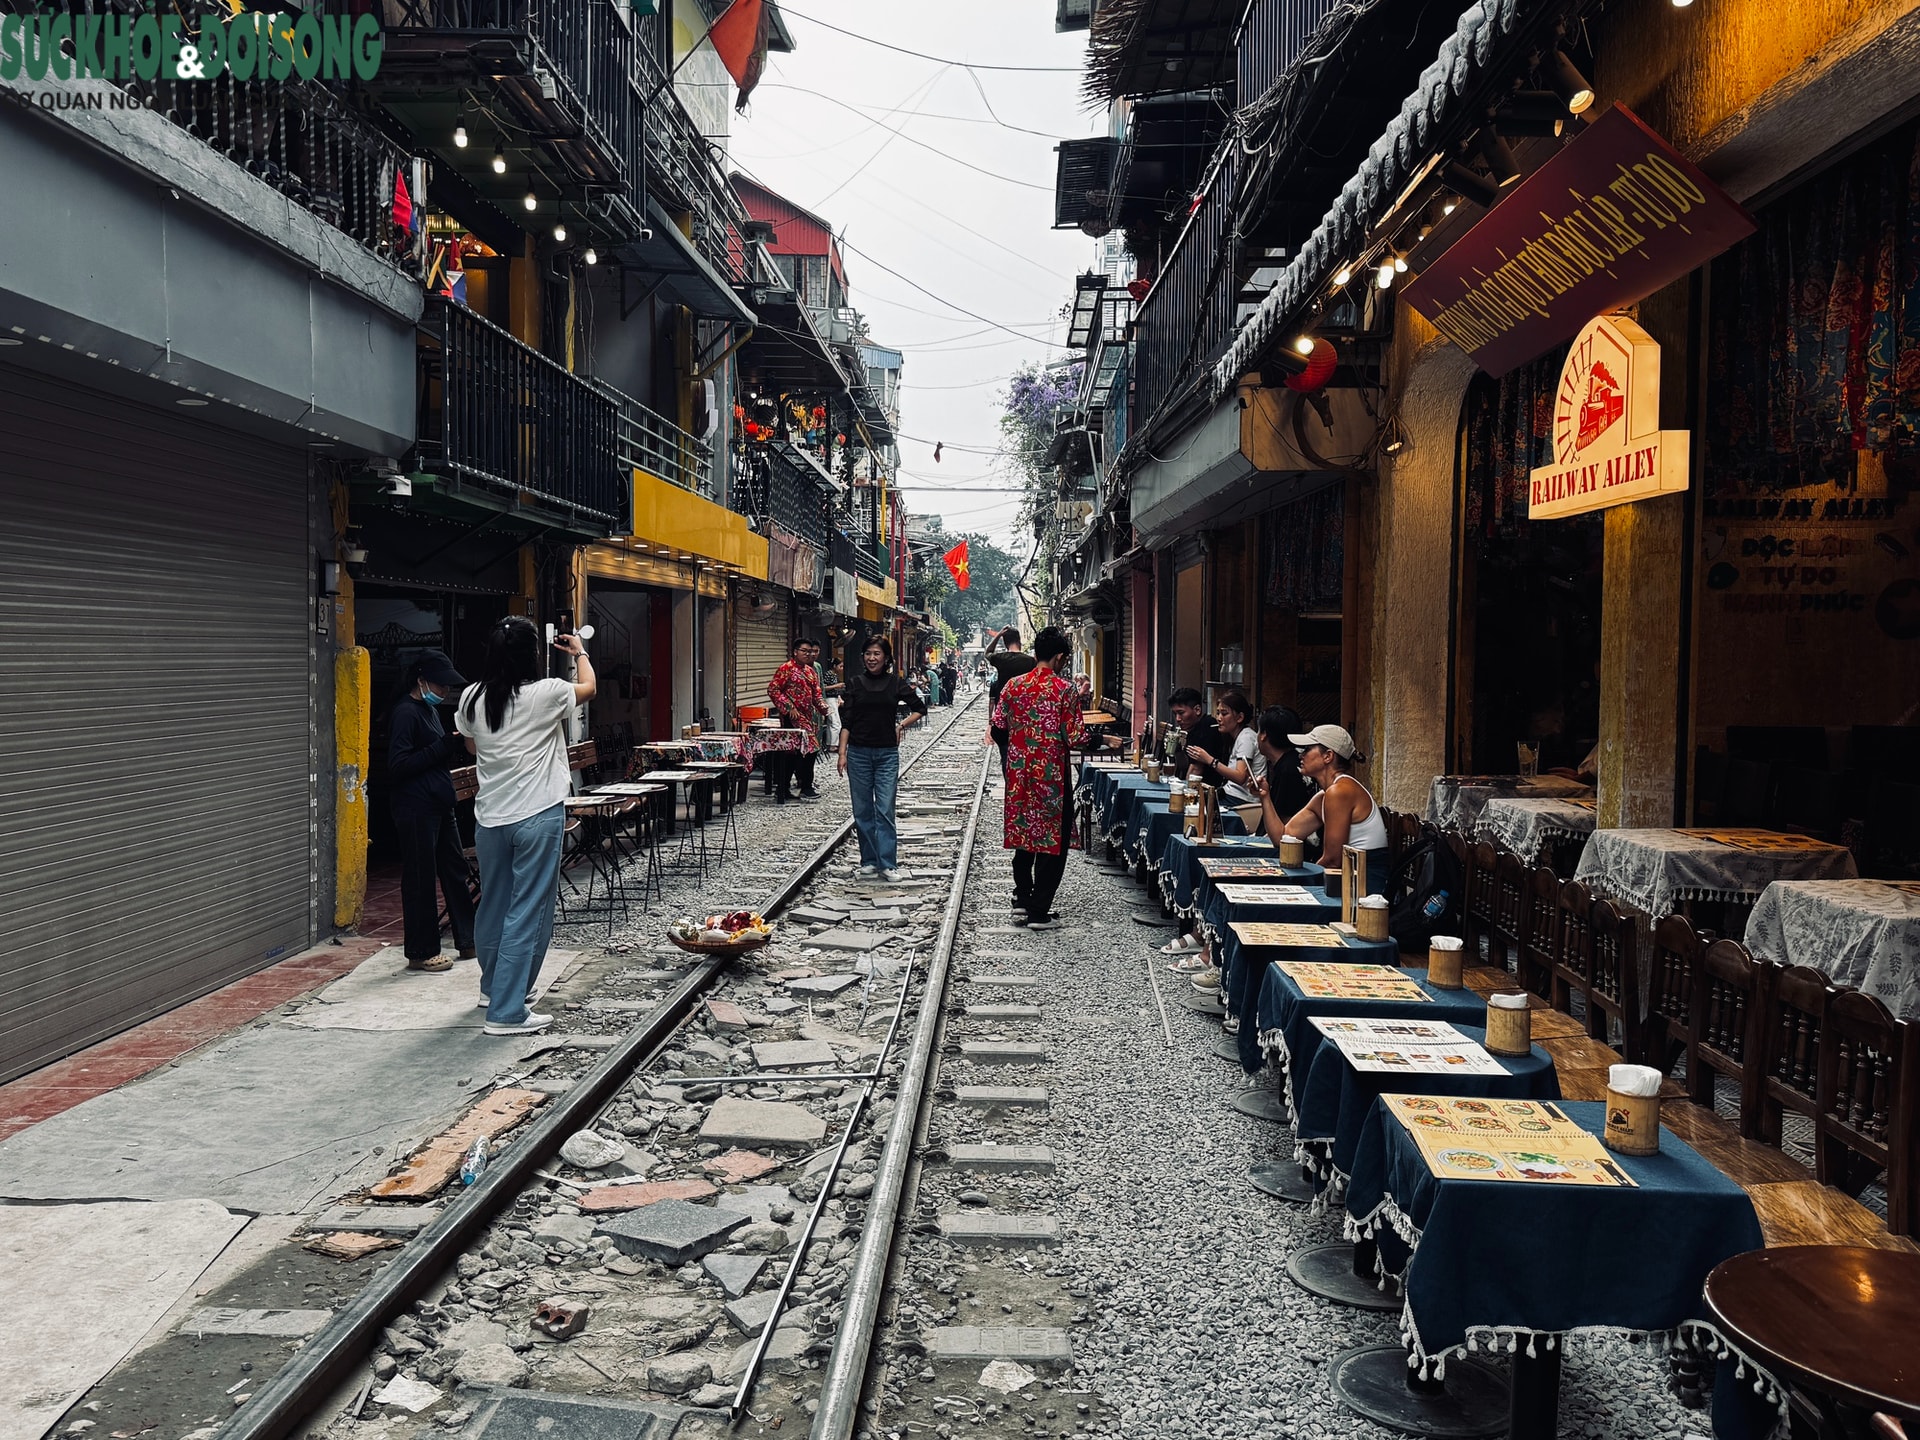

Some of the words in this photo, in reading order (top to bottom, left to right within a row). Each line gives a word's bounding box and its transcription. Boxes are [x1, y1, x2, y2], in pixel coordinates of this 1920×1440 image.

[1633, 153, 1706, 214] DO
[1540, 211, 1617, 280] ĐỘC
[1569, 188, 1650, 260] LẬP
[1472, 267, 1529, 321] GÌ
[1494, 247, 1555, 318] QUÝ
[1516, 238, 1584, 295] HƠN
[1432, 299, 1499, 354] KHÔNG
[1460, 277, 1515, 332] CÓ
[1531, 463, 1599, 506] RAILWAY
[1602, 446, 1657, 489] ALLEY
[1801, 567, 1836, 585] DO
